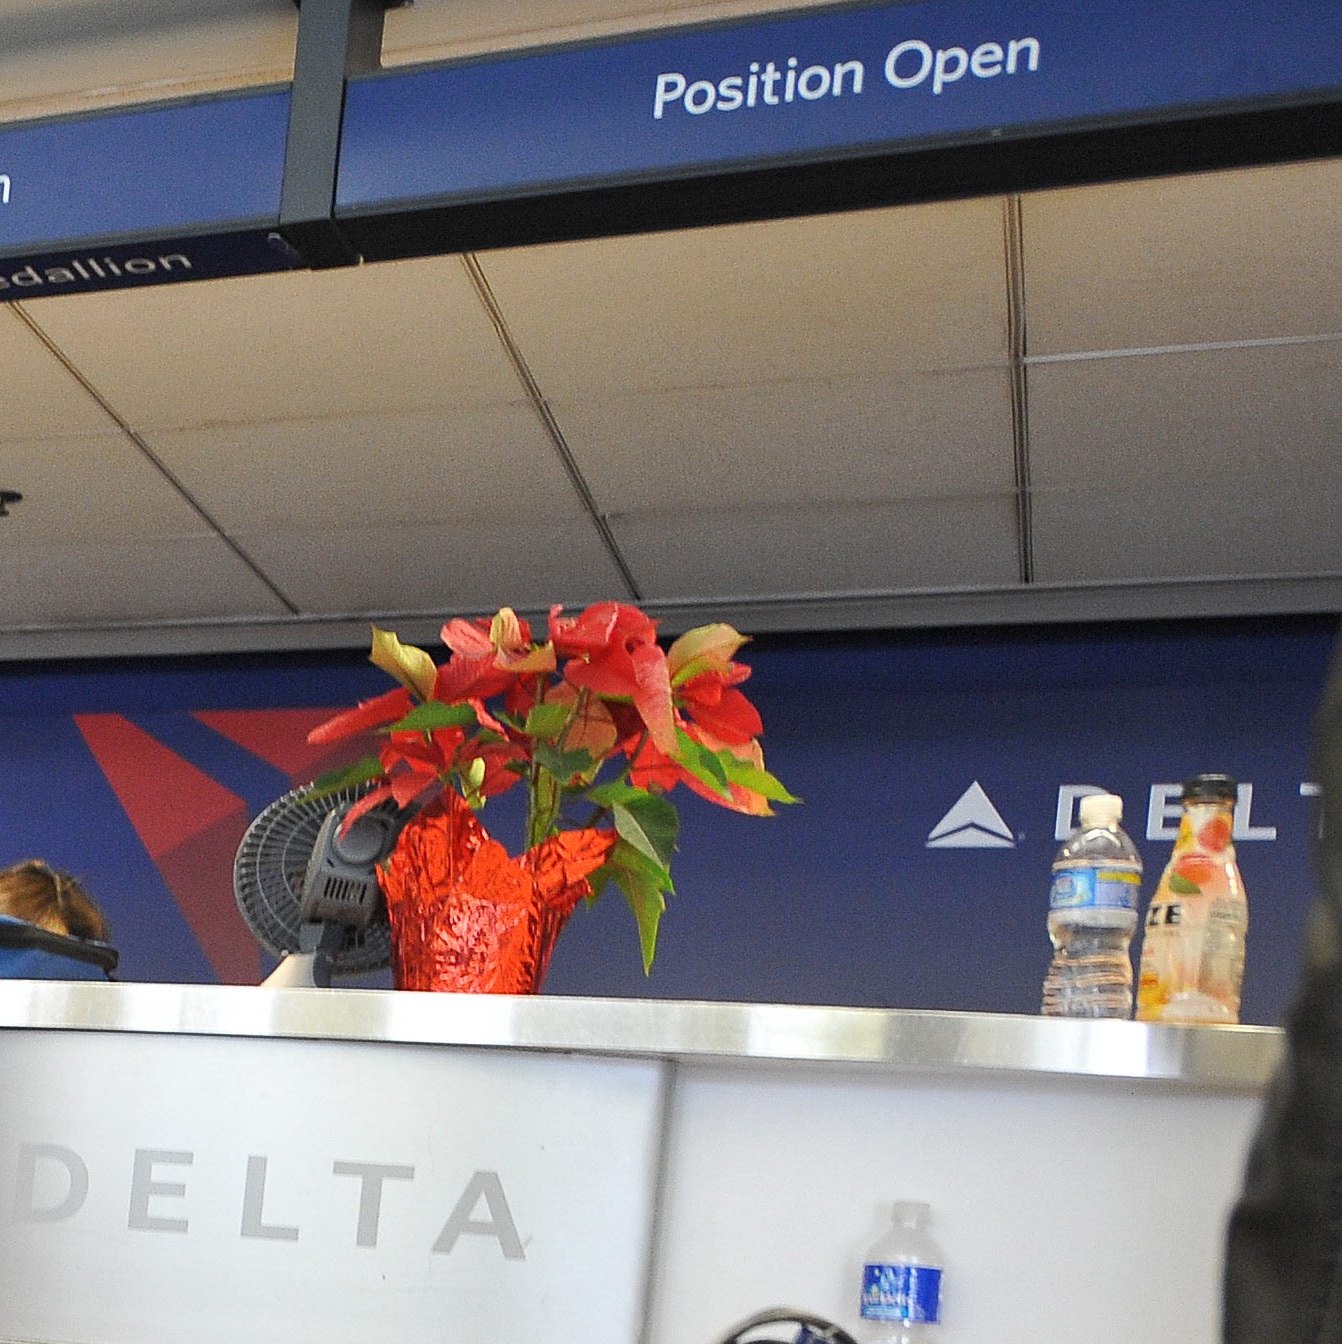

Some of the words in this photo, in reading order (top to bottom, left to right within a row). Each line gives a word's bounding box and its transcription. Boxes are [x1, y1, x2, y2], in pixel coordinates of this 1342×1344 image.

[652, 54, 864, 120] Position
[884, 35, 1041, 97] Open
[1054, 782, 1323, 841] DEL
[14, 1141, 528, 1263] DELTA
